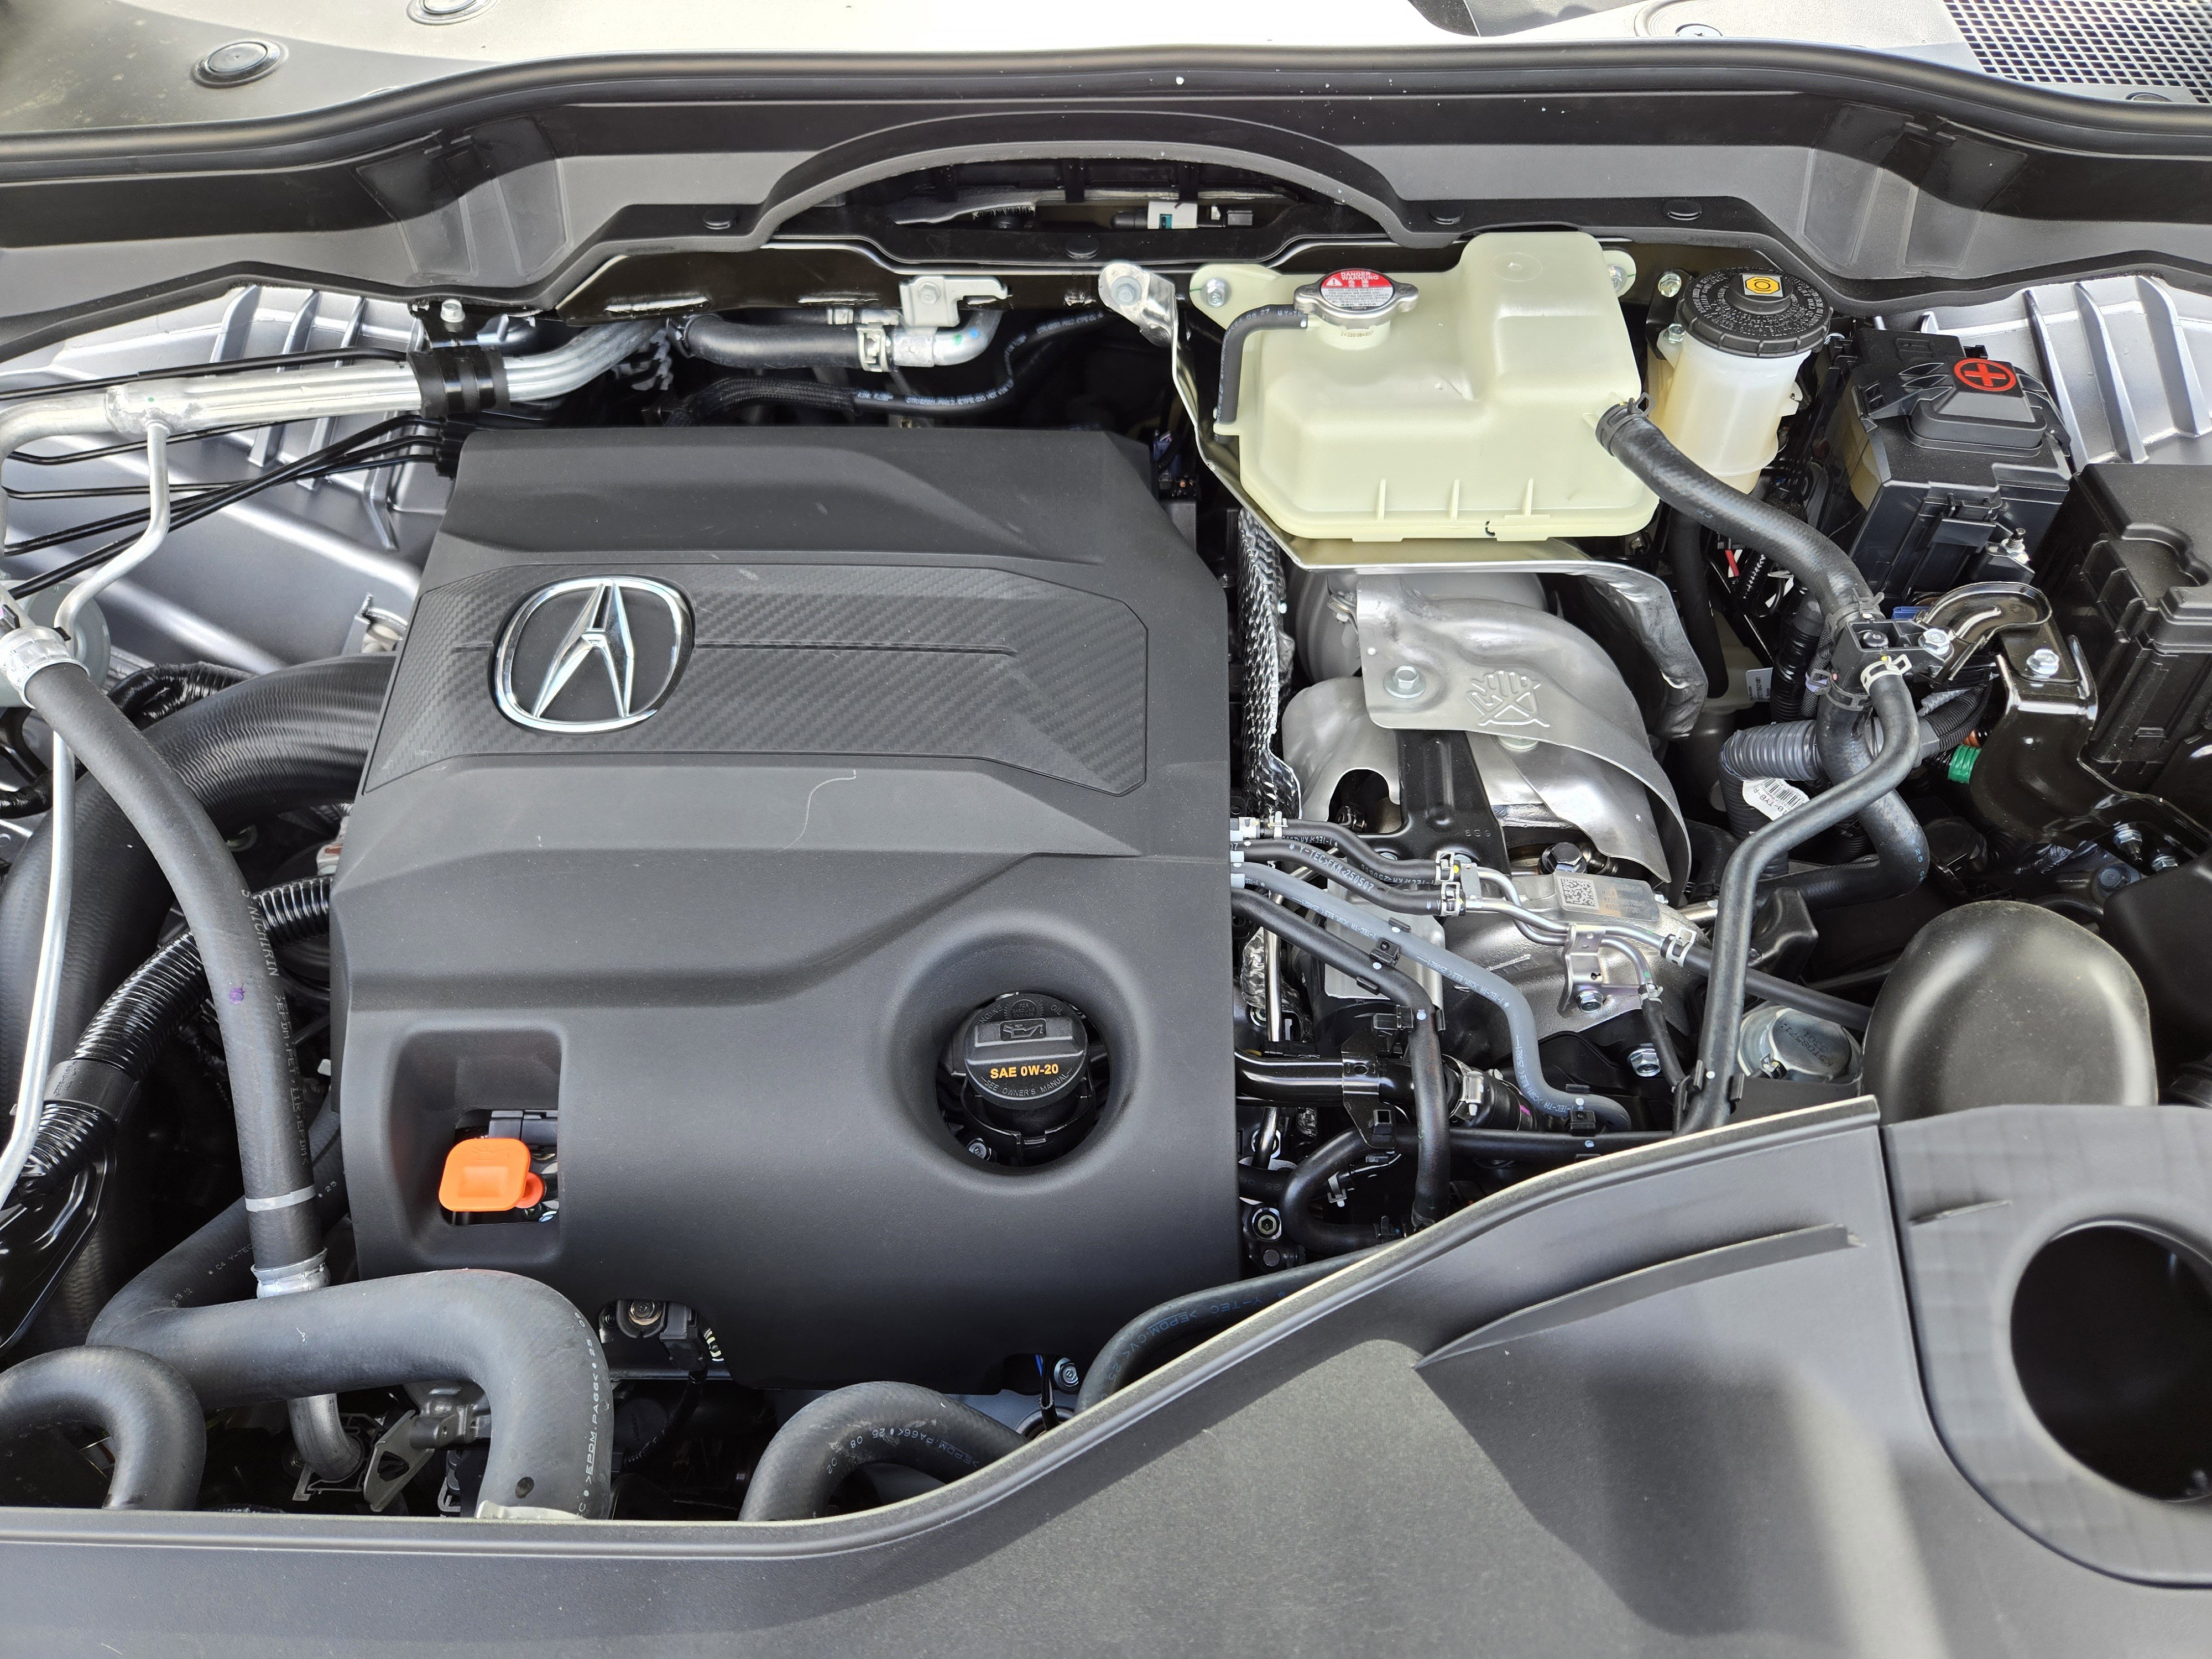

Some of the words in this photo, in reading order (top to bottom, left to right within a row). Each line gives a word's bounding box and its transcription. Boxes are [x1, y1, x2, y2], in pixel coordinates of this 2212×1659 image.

[1914, 847, 1923, 863] 25
[978, 1004, 1005, 1024] NGINE
[1050, 1004, 1064, 1016] OIL
[990, 1066, 1017, 1079] SAE
[1020, 1063, 1059, 1077] 0W-20
[1002, 1087, 1036, 1097] OWNER'S
[1040, 1073, 1070, 1093] MANUAL
[325, 1180, 337, 1193] 25
[1209, 1296, 1262, 1314] Y-TEC
[575, 1312, 586, 1327] 09
[586, 1338, 596, 1357] 25
[872, 1427, 885, 1438] 25
[850, 1435, 863, 1449] 08
[826, 1457, 838, 1475] 02
